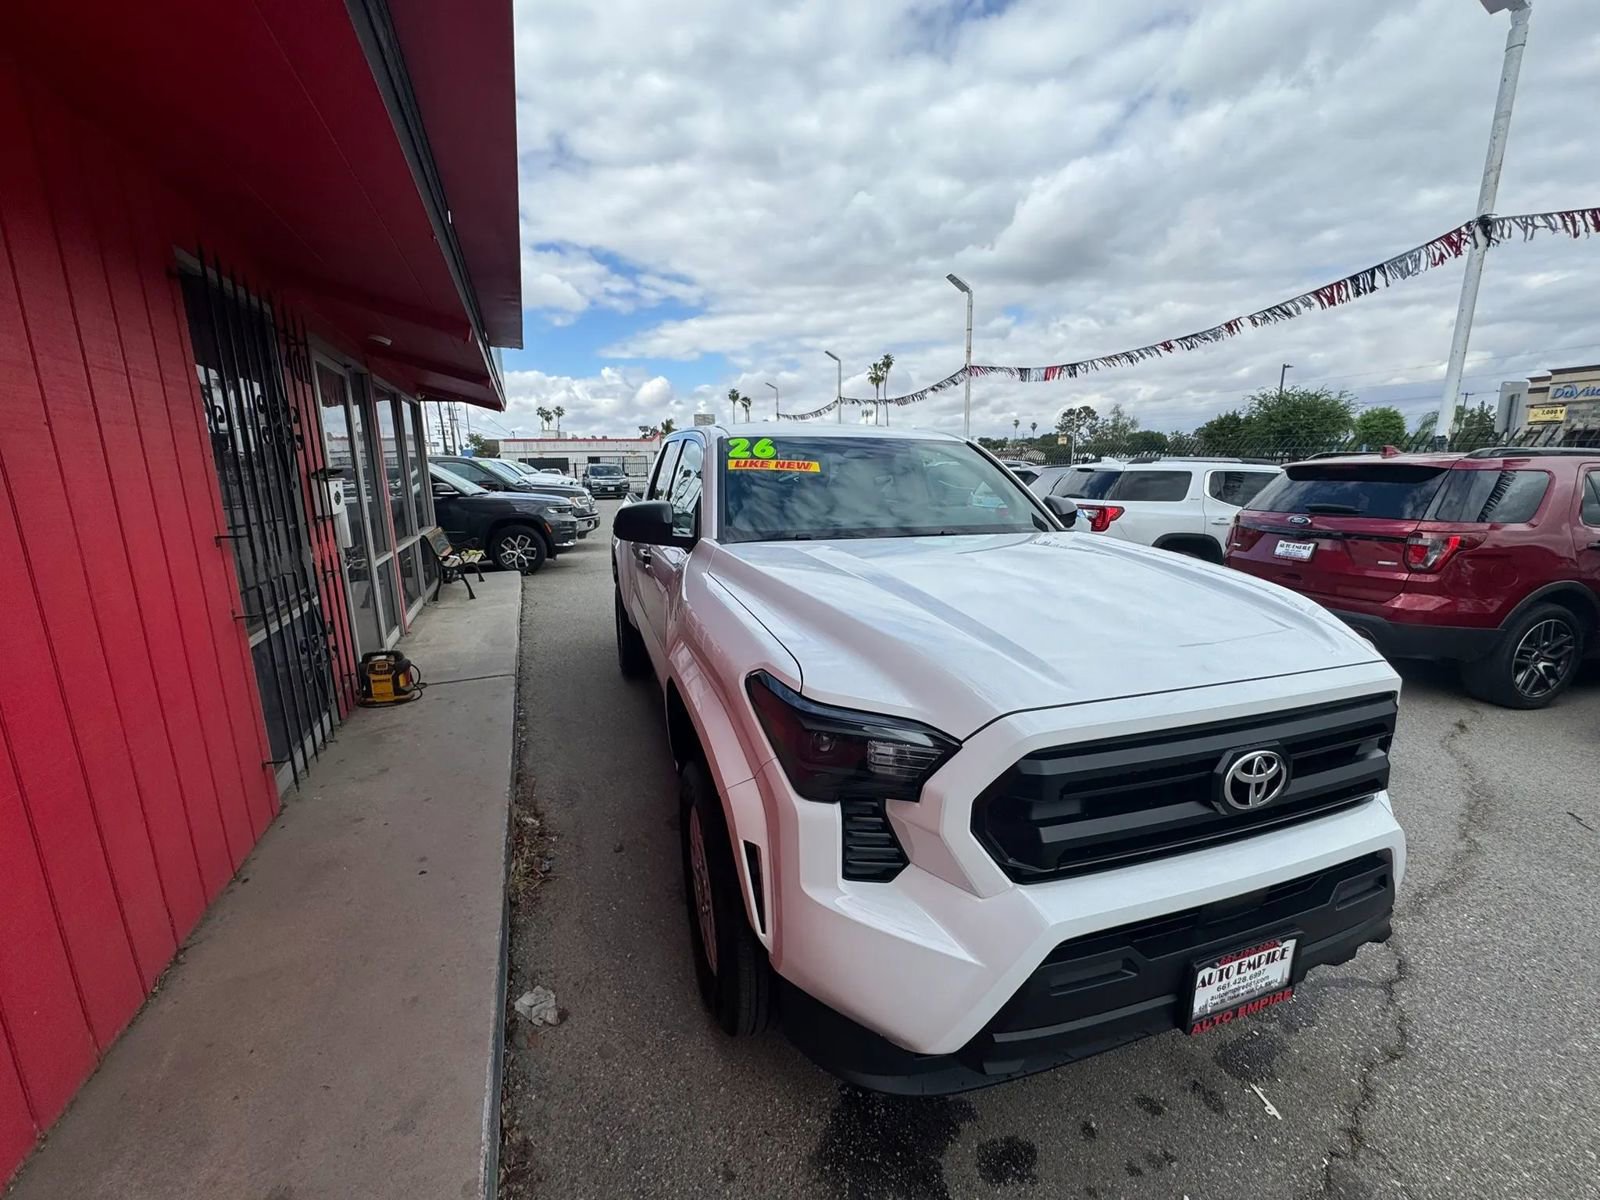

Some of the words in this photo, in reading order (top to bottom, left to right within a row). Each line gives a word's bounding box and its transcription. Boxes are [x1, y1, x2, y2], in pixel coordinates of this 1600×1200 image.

[728, 438, 776, 459] 26
[734, 460, 770, 468] LIKE
[775, 461, 812, 470] NEW
[1196, 965, 1235, 990] AUTO
[1236, 946, 1290, 976] EMPIRE
[1190, 1011, 1233, 1036] AUTO
[1237, 988, 1294, 1018] EMPIRE
